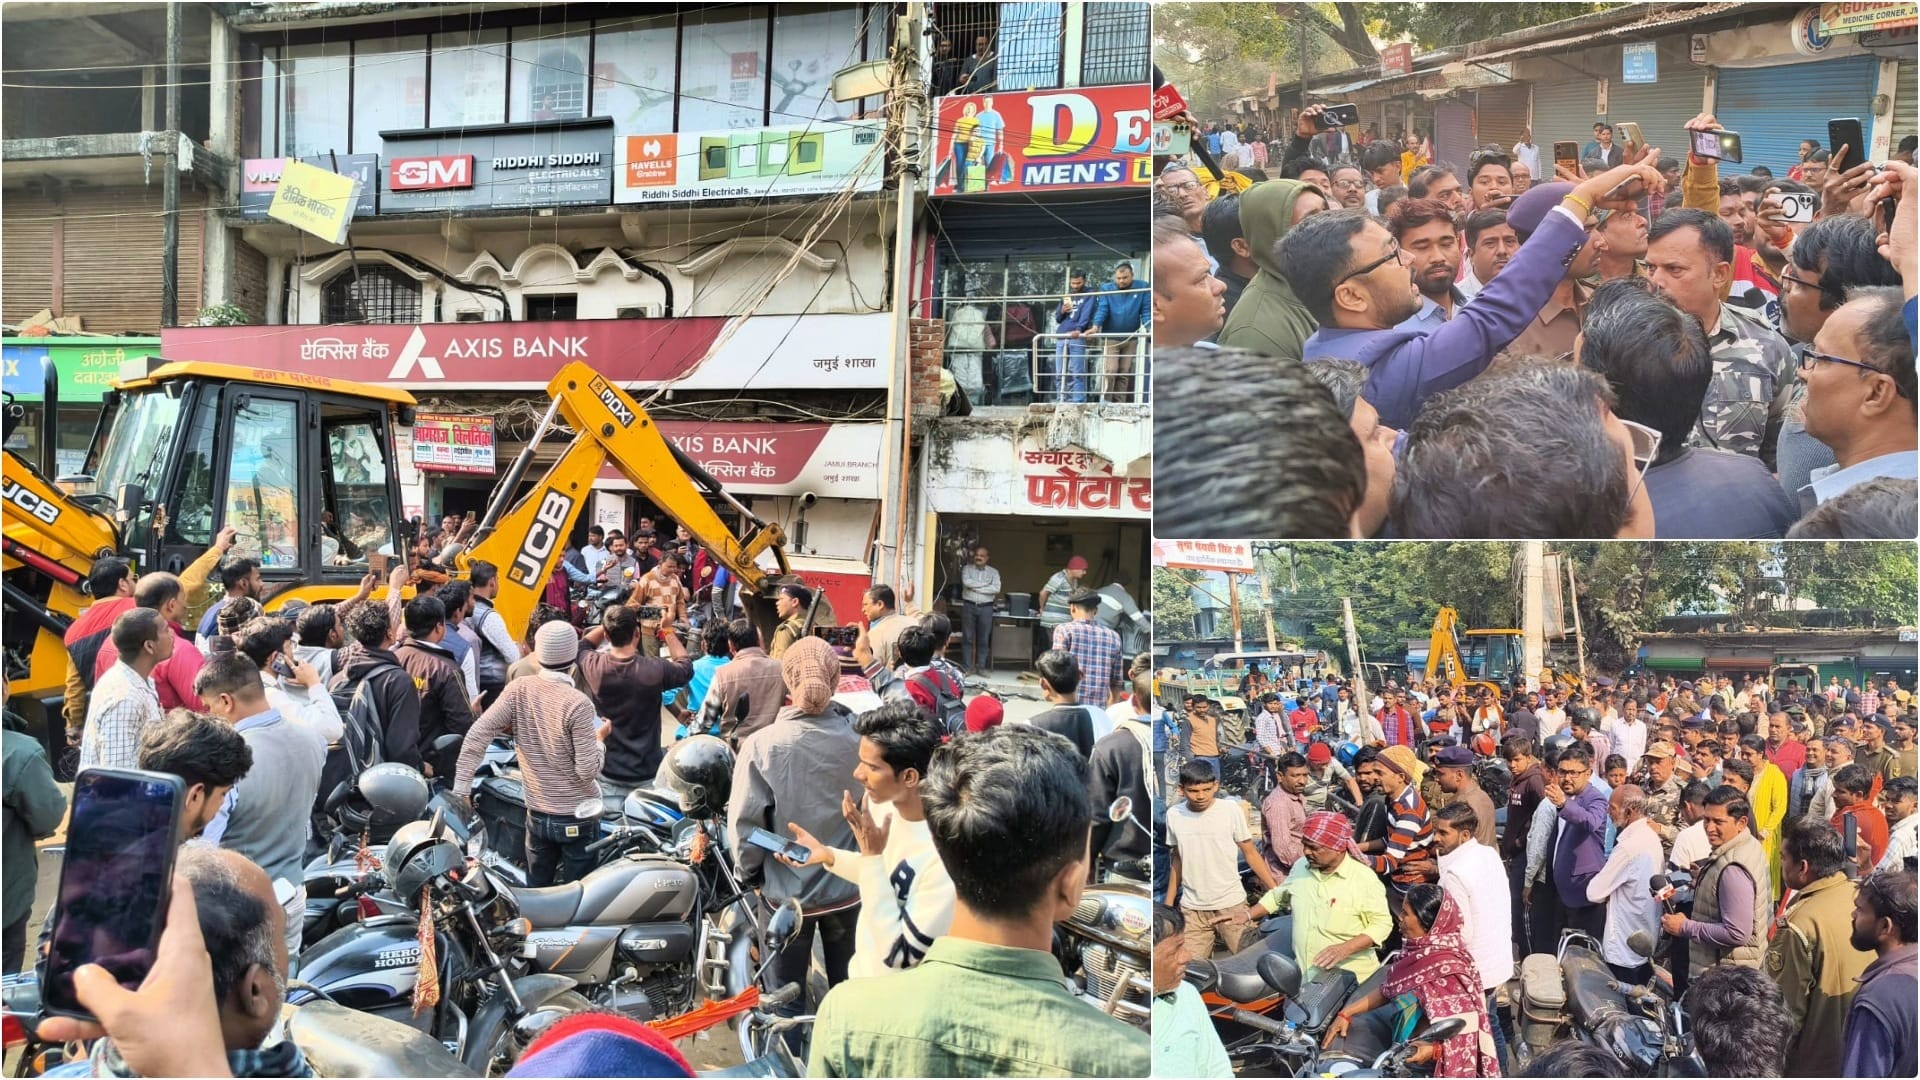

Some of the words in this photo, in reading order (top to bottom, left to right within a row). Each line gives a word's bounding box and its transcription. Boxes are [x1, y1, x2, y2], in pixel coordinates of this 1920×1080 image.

[1843, 14, 1874, 24] MEDICINE
[493, 155, 544, 170] RIDDHI
[548, 152, 600, 167] SIDDHI
[631, 160, 673, 171] HAVELLS
[399, 159, 467, 185] GM
[1024, 162, 1121, 185] MEN'S
[642, 190, 670, 200] Riddhi
[672, 188, 700, 199] Siddhi
[300, 337, 357, 360] ऐक्सिस
[362, 337, 390, 359] बैंक
[444, 338, 503, 359] AXIS
[513, 336, 588, 358] BANK
[813, 357, 839, 371] जमुई
[844, 357, 877, 369] शाखा
[672, 437, 704, 453] XIS
[712, 436, 778, 455] BANK
[847, 461, 879, 469] BRANCH
[1025, 448, 1073, 465] संचार
[751, 460, 776, 478] बैंक
[824, 474, 839, 484] जमुई
[2, 483, 59, 523] JCB
[517, 491, 571, 586] JCB
[380, 948, 420, 959] HERO
